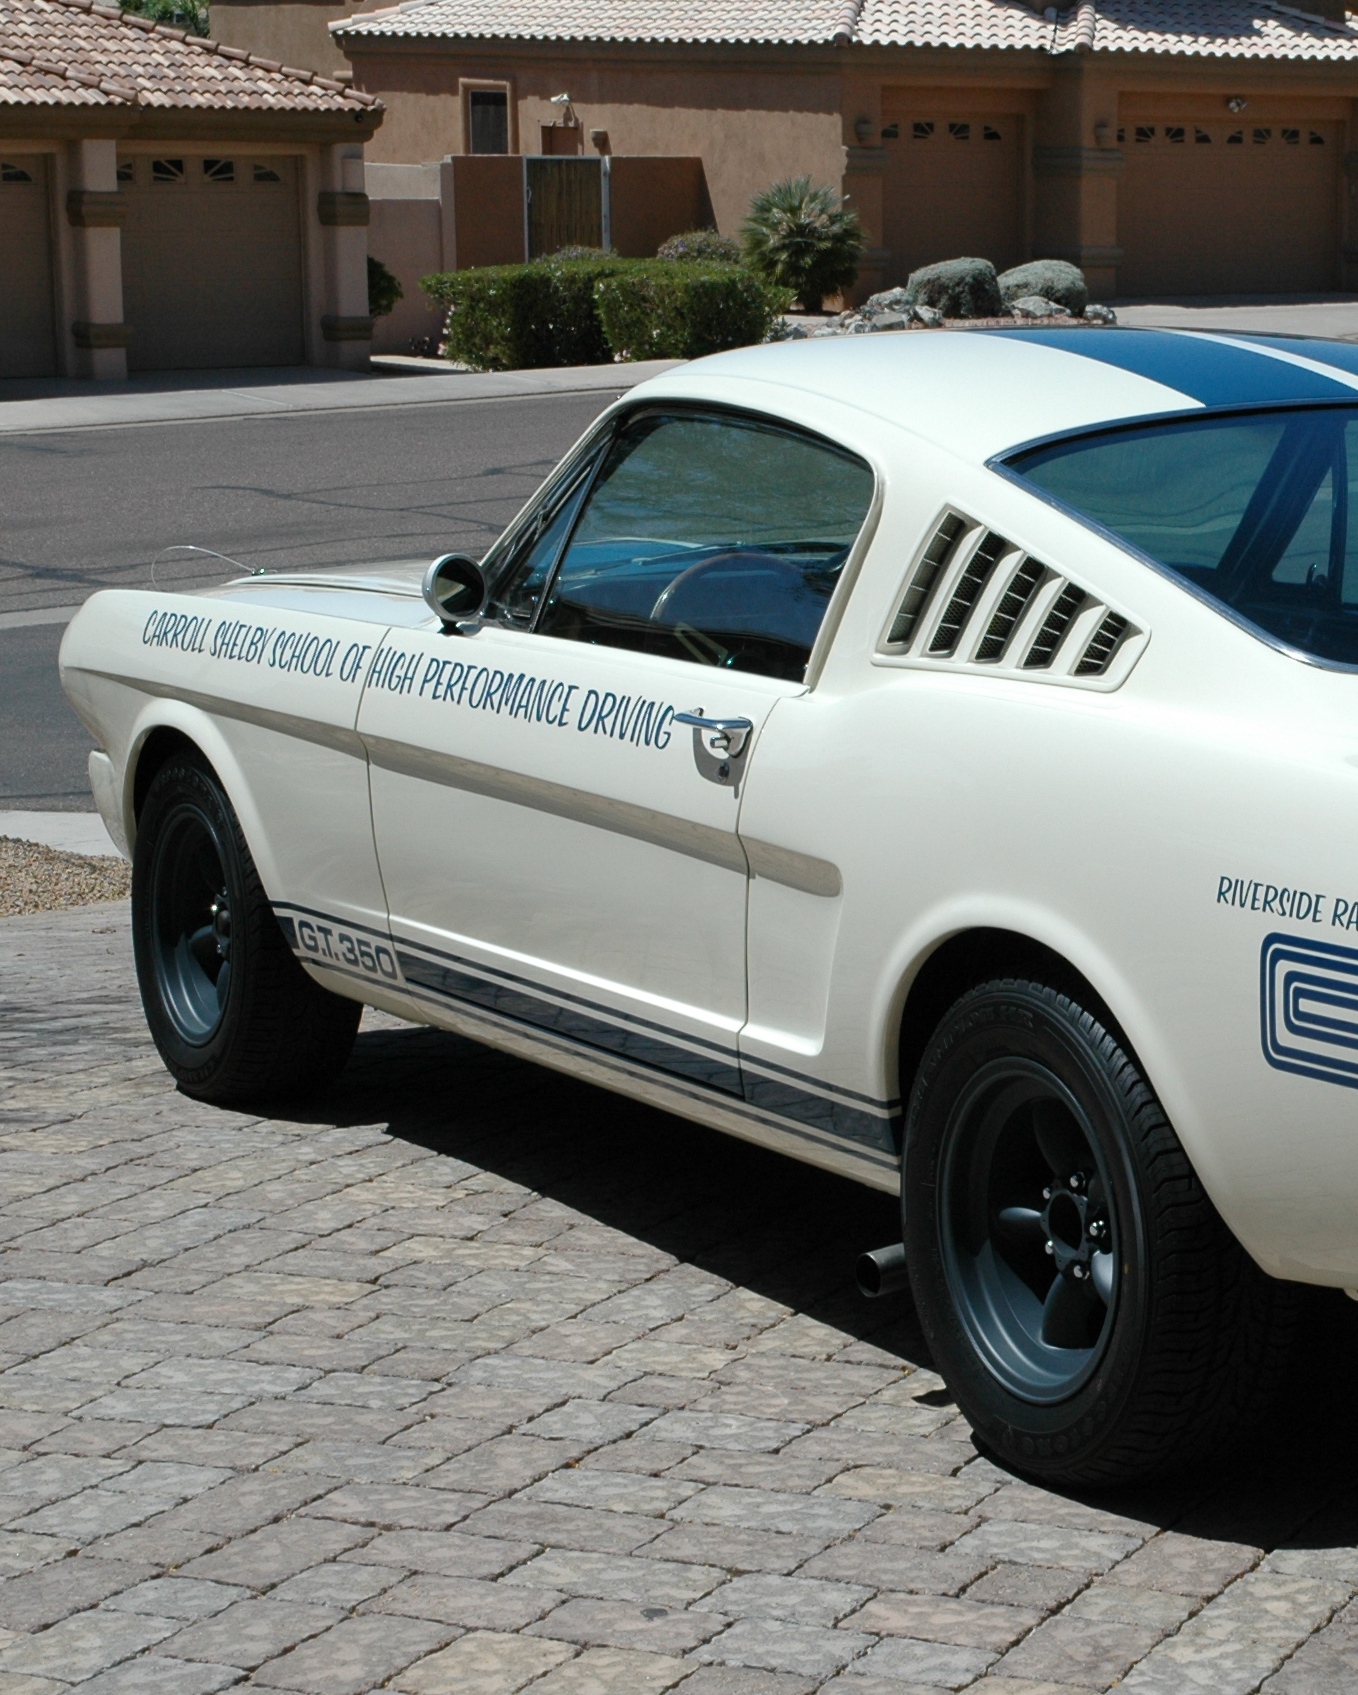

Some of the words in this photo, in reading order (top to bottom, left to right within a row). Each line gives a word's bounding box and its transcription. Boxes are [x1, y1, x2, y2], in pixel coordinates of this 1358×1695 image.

[142, 610, 212, 654] CARROLL
[209, 619, 277, 664] SHELBY
[268, 630, 341, 678] SCHOOL
[339, 642, 372, 683] OF
[367, 646, 424, 694] HIGH
[418, 657, 579, 727] PERFORMANCE
[577, 689, 675, 750] DRIVING
[1216, 875, 1327, 923] RIVERSIDE
